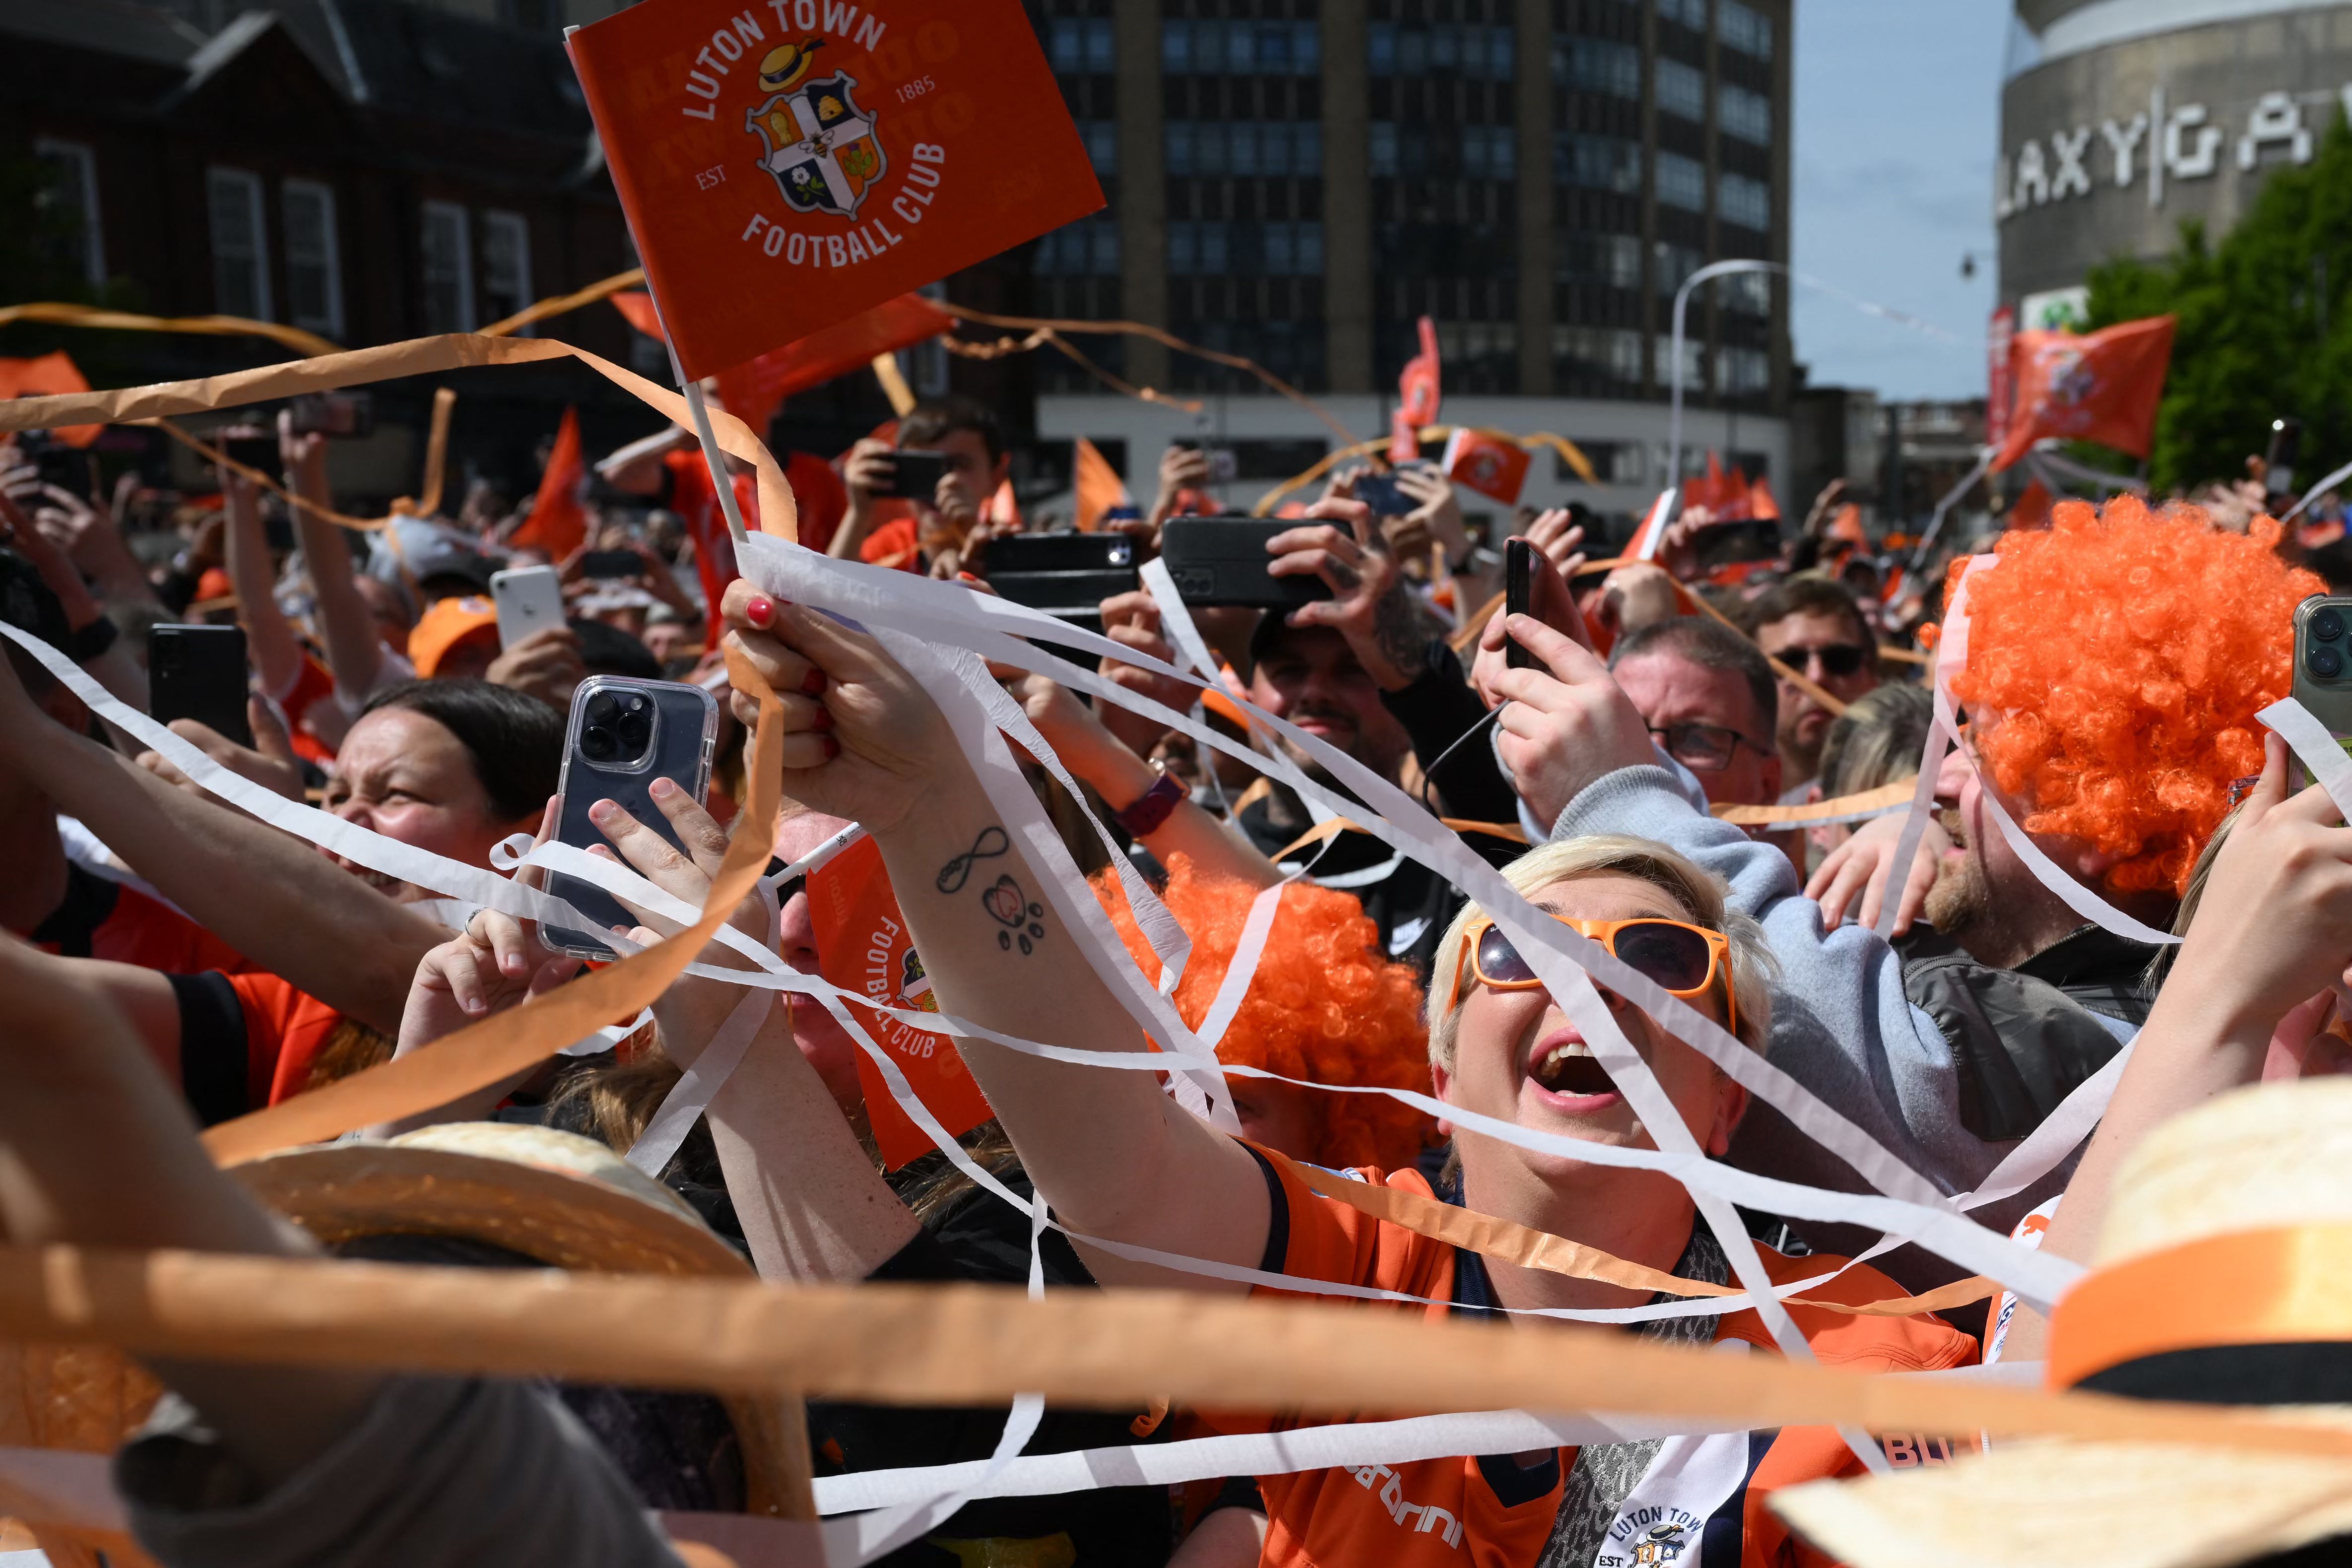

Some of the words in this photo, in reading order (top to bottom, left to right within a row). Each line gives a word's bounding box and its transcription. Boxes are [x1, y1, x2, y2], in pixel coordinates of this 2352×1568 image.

[682, 9, 765, 121] LUTON
[767, 0, 886, 52] TOWN
[895, 75, 935, 103] 1885
[695, 164, 726, 191] EST
[741, 213, 903, 267] FOOTBALL
[892, 142, 945, 224] CLUB
[866, 915, 900, 1033] FOOTBALL
[891, 1024, 936, 1058] CLUB
[1609, 1506, 1662, 1542] LUTON
[1669, 1506, 1703, 1532] TOW
[1599, 1556, 1623, 1568] EST
